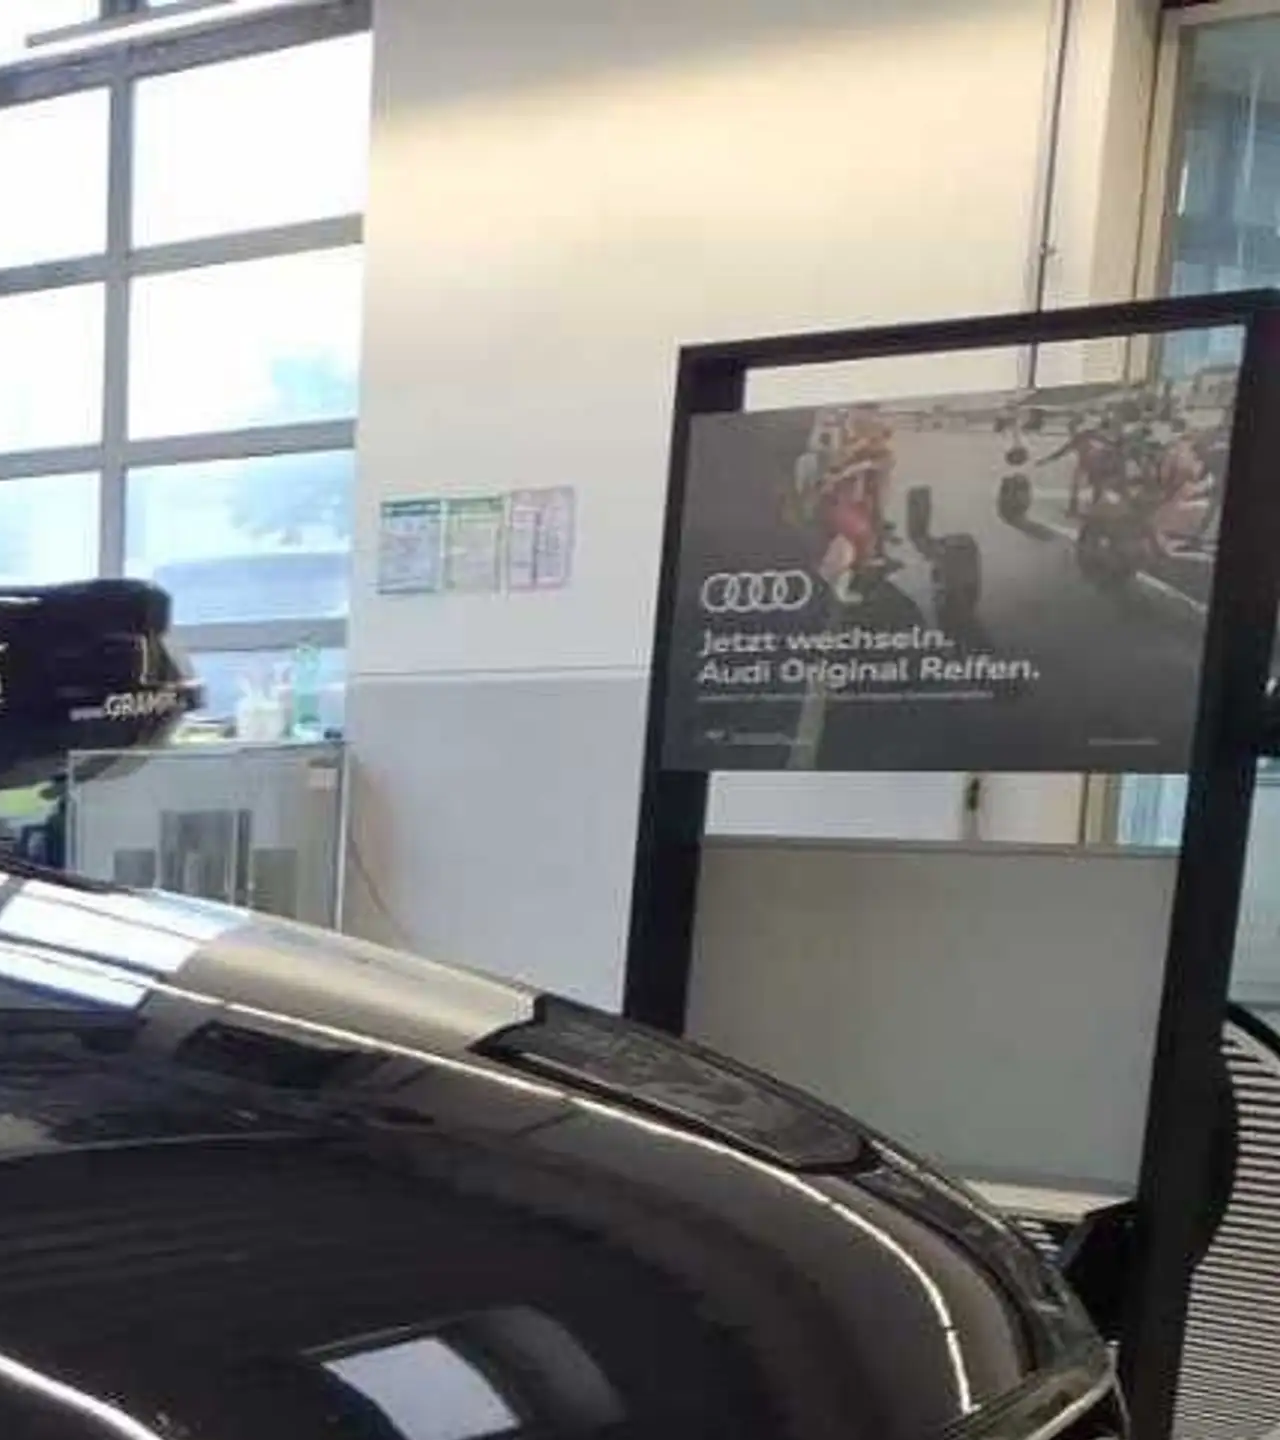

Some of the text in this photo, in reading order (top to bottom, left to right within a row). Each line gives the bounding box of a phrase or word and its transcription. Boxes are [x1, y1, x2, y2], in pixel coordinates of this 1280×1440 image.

[698, 625, 955, 657] Jetzt wechseln.
[698, 654, 1040, 688] Audi Original Reifen.
